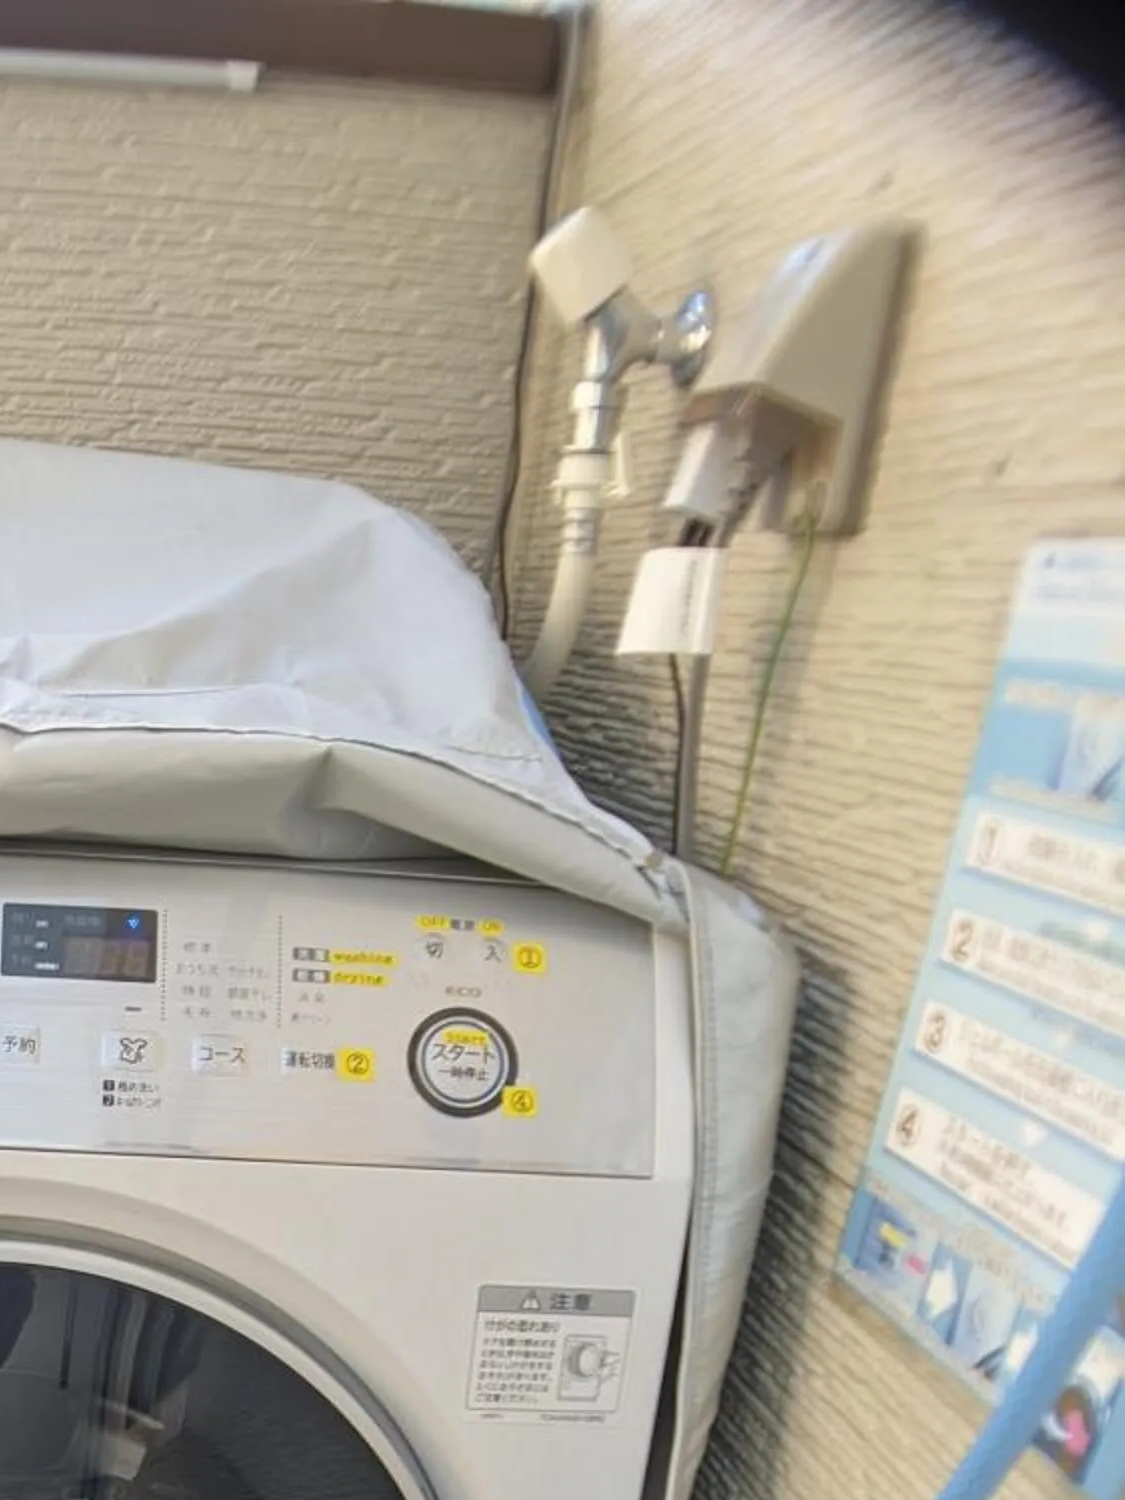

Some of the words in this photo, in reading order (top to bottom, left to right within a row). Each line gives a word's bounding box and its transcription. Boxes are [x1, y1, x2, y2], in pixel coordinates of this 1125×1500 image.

[3, 1034, 36, 1054] 予約
[431, 1043, 496, 1064] スタート
[199, 1046, 245, 1064] コース
